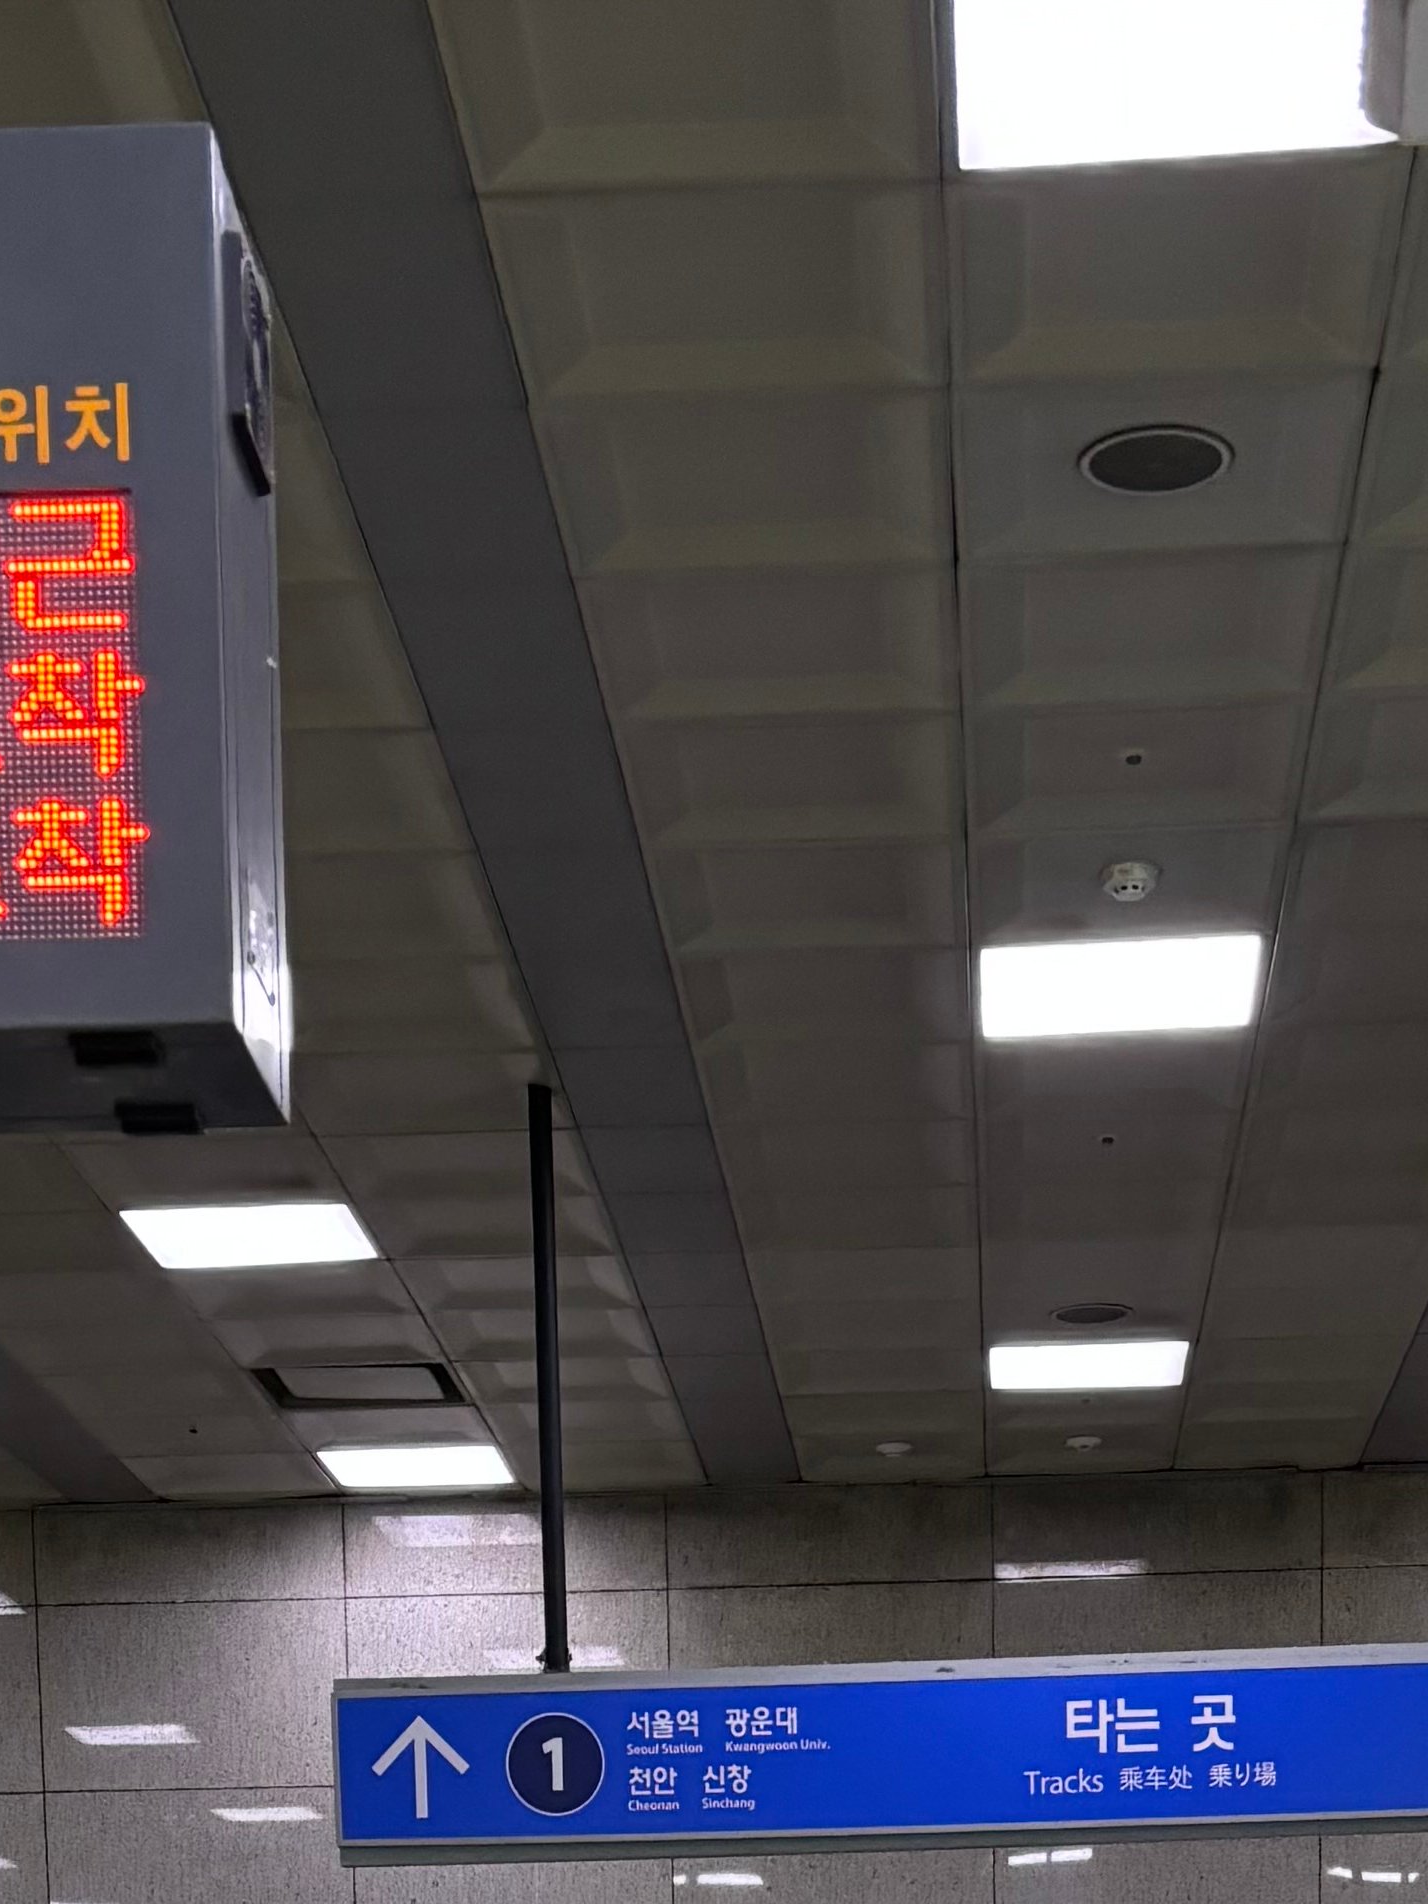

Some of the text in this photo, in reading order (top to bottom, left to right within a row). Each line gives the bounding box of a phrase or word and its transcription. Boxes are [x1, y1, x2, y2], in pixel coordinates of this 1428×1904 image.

[626, 1706, 799, 1739] 서울역 광운대
[1066, 1694, 1236, 1753] 타는 곳
[626, 1738, 831, 1756] Seoul Station Kwangwoon Univ.
[540, 1736, 565, 1793] 1
[628, 1764, 753, 1796] 천안 신창
[1023, 1767, 1104, 1796] Tracks
[628, 1797, 756, 1812] Cheonan Sinchang
